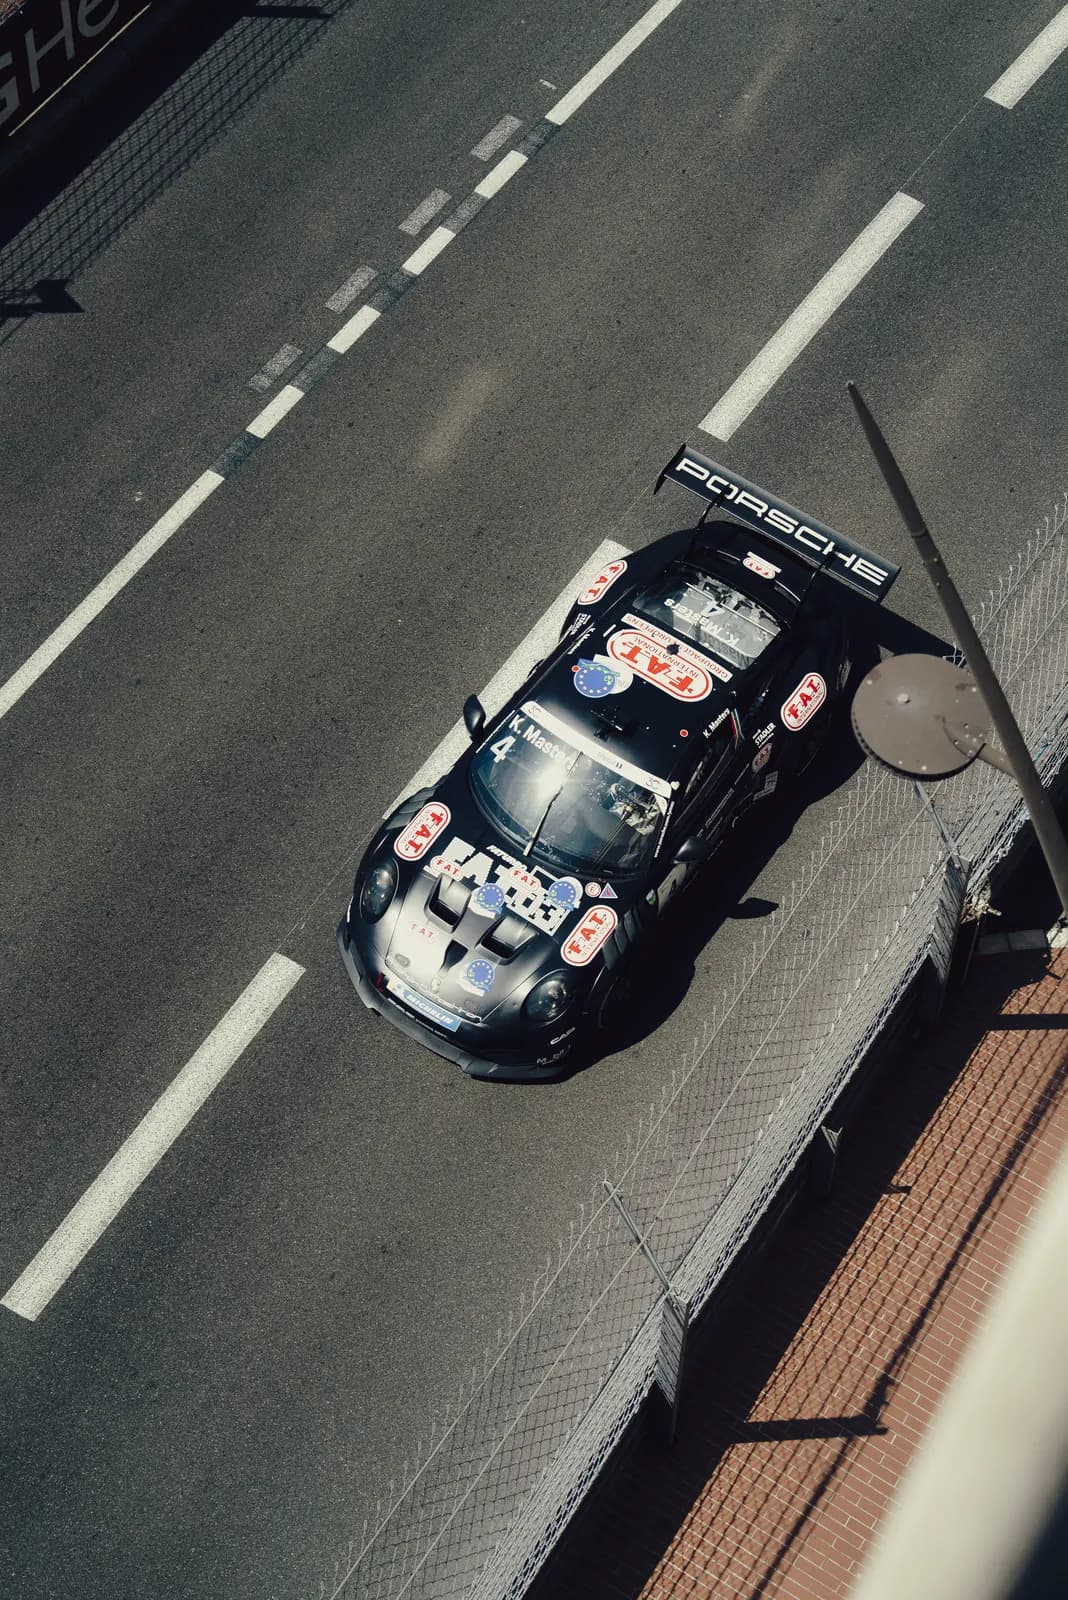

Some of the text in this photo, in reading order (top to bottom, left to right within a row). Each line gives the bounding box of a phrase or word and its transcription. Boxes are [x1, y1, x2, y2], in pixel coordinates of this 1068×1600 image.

[675, 457, 889, 586] PORSCHE
[588, 565, 620, 598] FAT
[663, 598, 723, 636] Masters
[619, 645, 695, 692] FAT
[634, 636, 700, 679] INTERNATIONAL
[787, 679, 818, 720] FAT
[508, 714, 523, 734] K.
[754, 722, 777, 746] STADLER
[490, 735, 516, 763] 4
[407, 811, 444, 854] FAT
[436, 859, 461, 875] FAT
[513, 869, 537, 887] FAT
[411, 923, 435, 938] FAT
[568, 912, 605, 954] FAT
